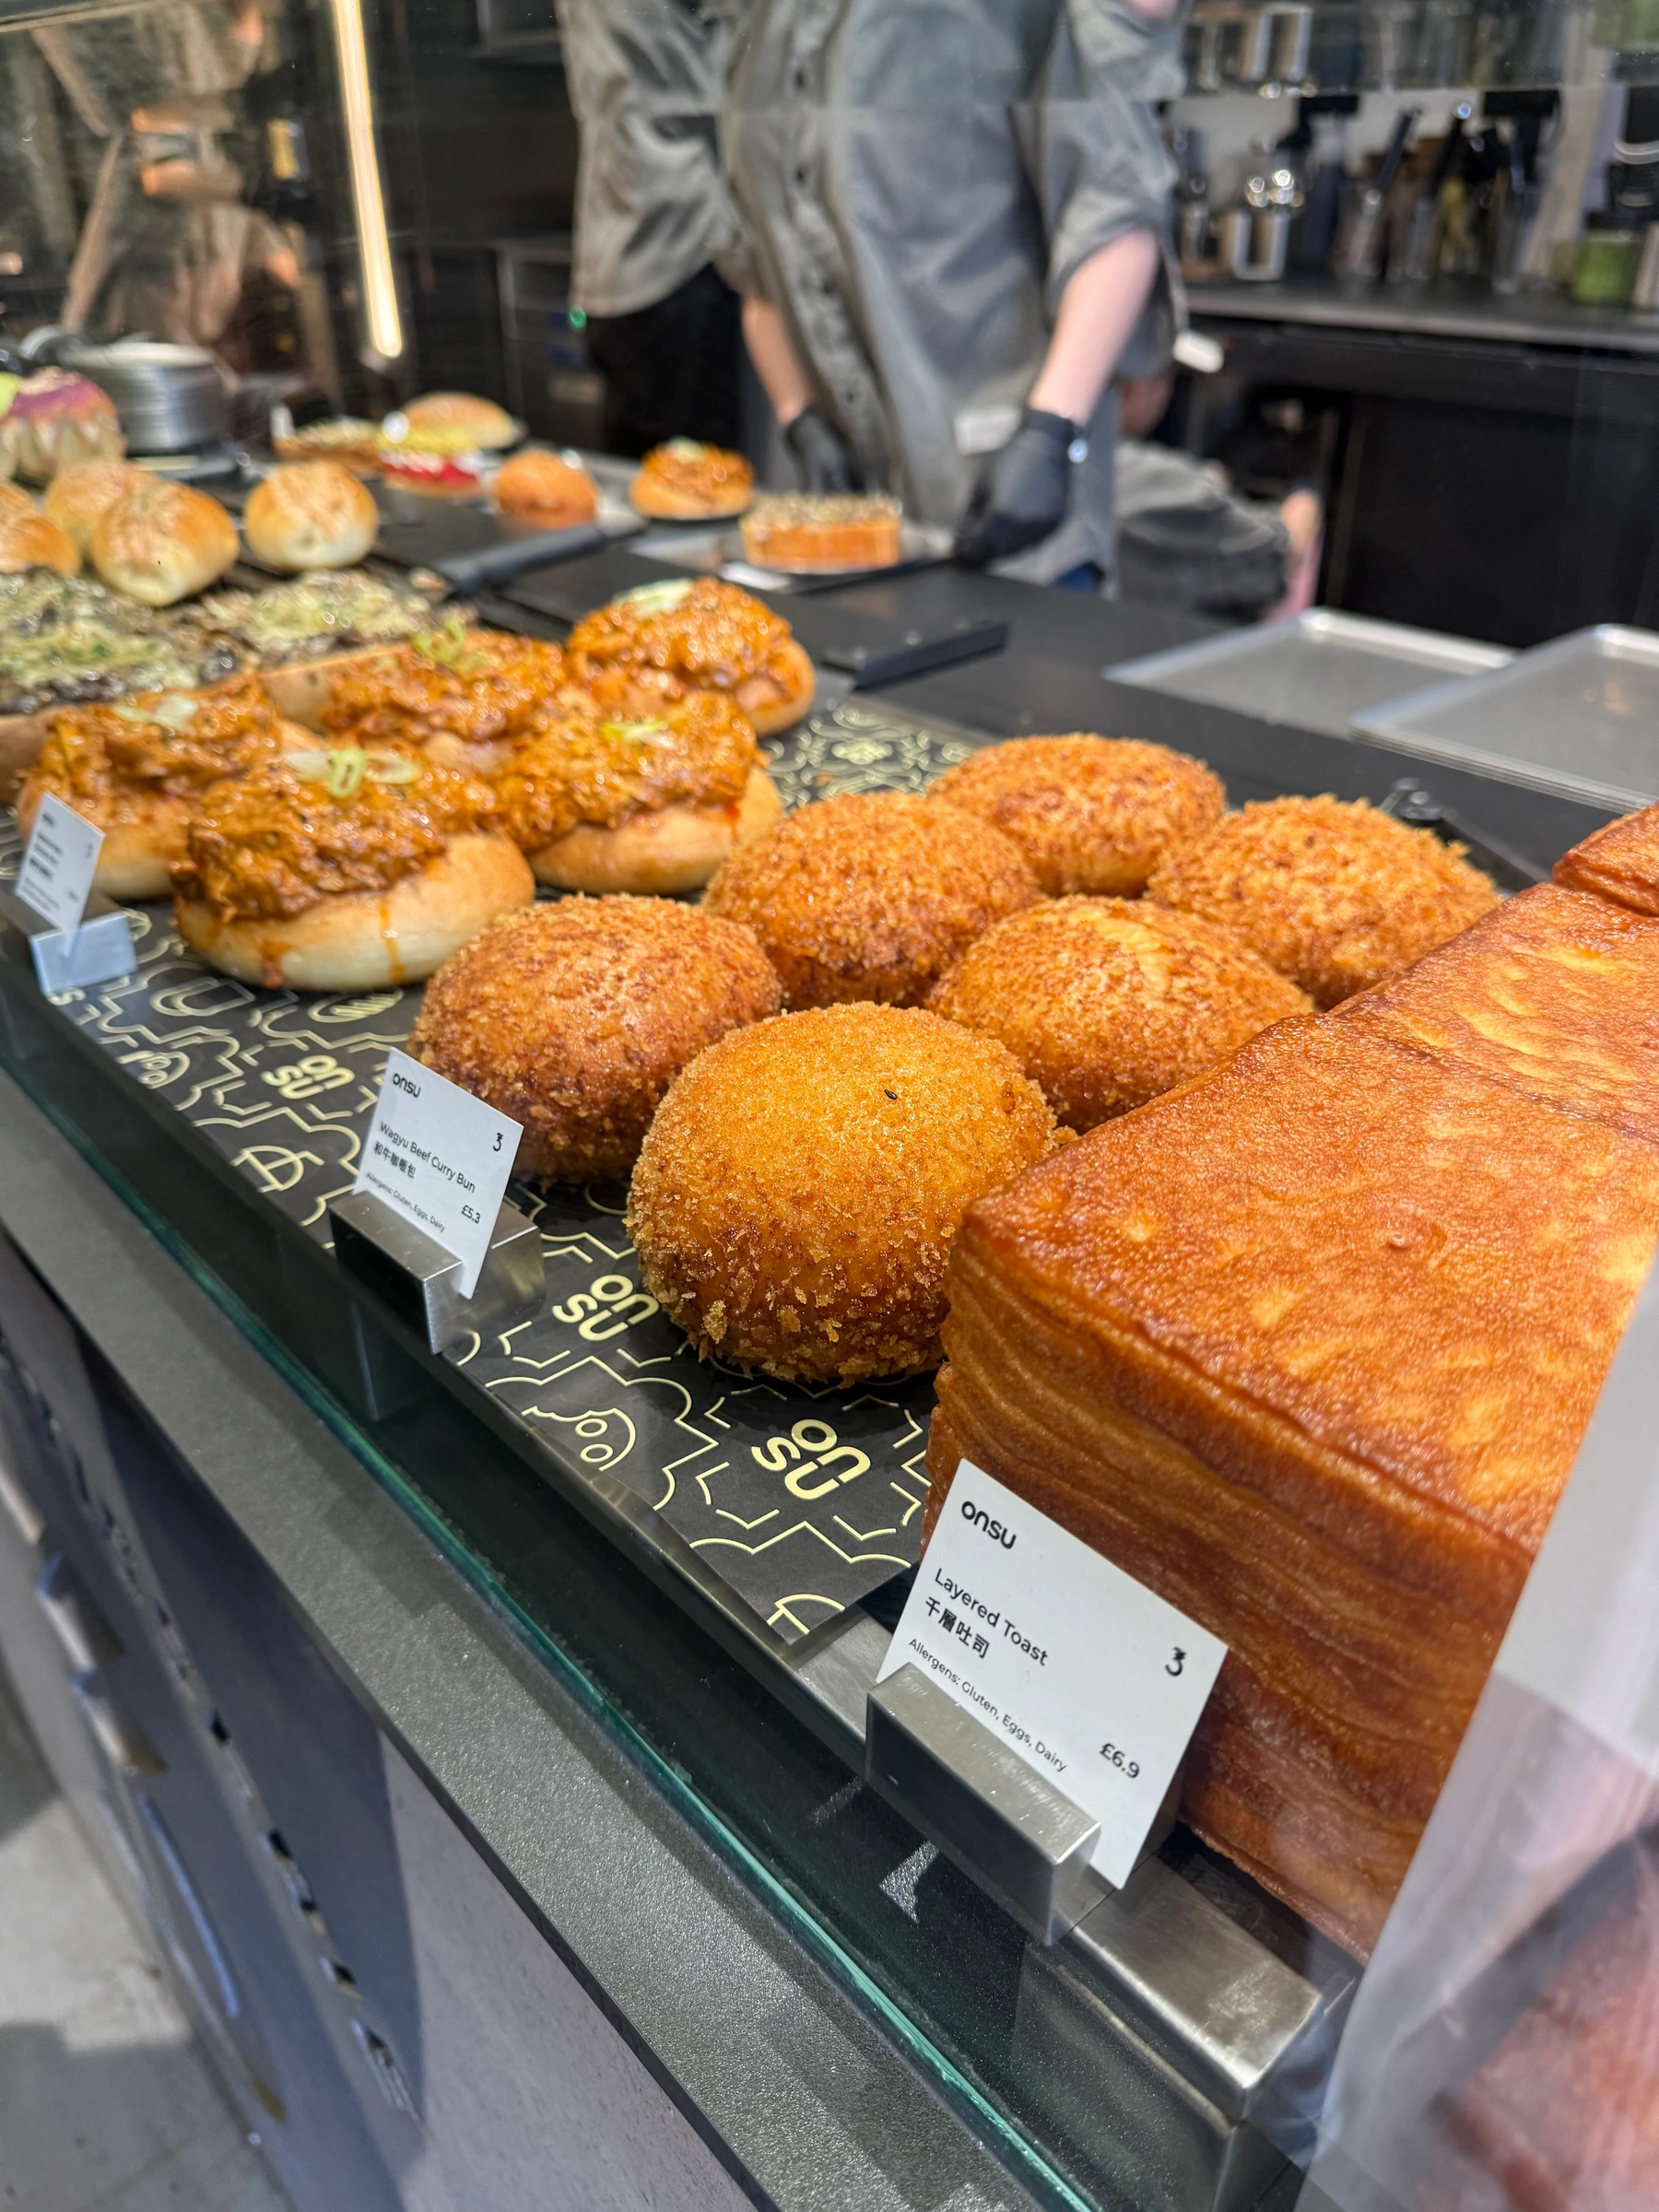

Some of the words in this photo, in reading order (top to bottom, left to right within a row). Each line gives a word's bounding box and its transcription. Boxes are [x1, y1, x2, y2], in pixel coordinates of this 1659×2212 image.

[393, 1073, 421, 1099] onsu
[380, 1122, 409, 1148] Wagyu
[410, 1141, 432, 1162] Beef
[431, 1156, 456, 1181] Curry
[456, 1172, 476, 1194] Bun
[429, 1215, 446, 1233] Dairy
[461, 1205, 481, 1224] £5.3
[960, 1500, 1017, 1549] onsu
[925, 1596, 990, 1658] 千層吐司
[935, 1568, 1000, 1628] Layered
[1003, 1618, 1048, 1666] Toast
[909, 1638, 961, 1686] Allergens:
[961, 1681, 999, 1720] Gluten,
[1002, 1714, 1032, 1747] Eggs,
[1035, 1741, 1066, 1772] Dairy
[1099, 1743, 1141, 1780] £6.9
